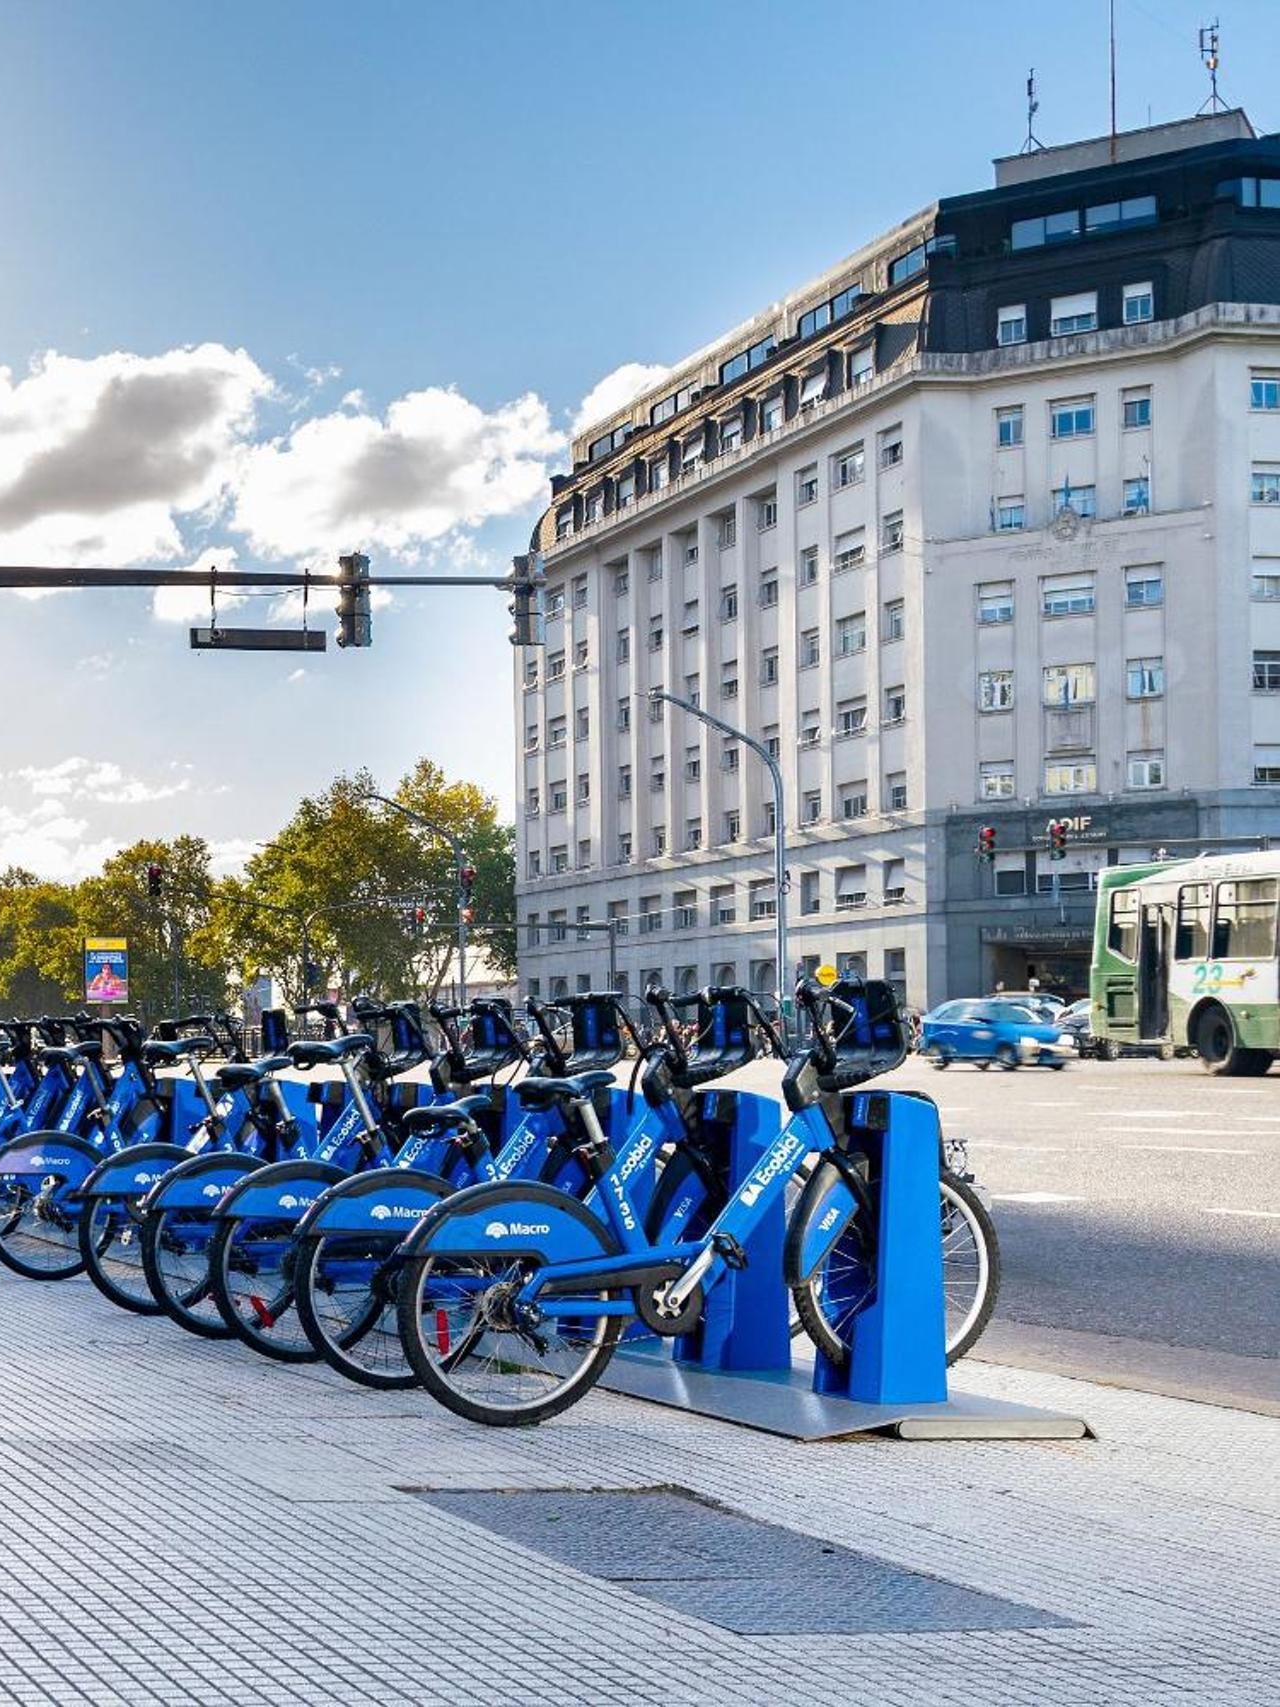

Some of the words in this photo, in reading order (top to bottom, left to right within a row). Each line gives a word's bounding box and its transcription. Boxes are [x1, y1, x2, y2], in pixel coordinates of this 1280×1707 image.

[1046, 816, 1092, 832] ADIF
[1192, 964, 1224, 993] 23
[755, 1133, 799, 1185] Ecobici
[393, 1206, 429, 1218] Macr
[673, 1197, 693, 1218] VISA
[509, 1223, 550, 1235] Macro
[818, 1207, 840, 1231] VISA
